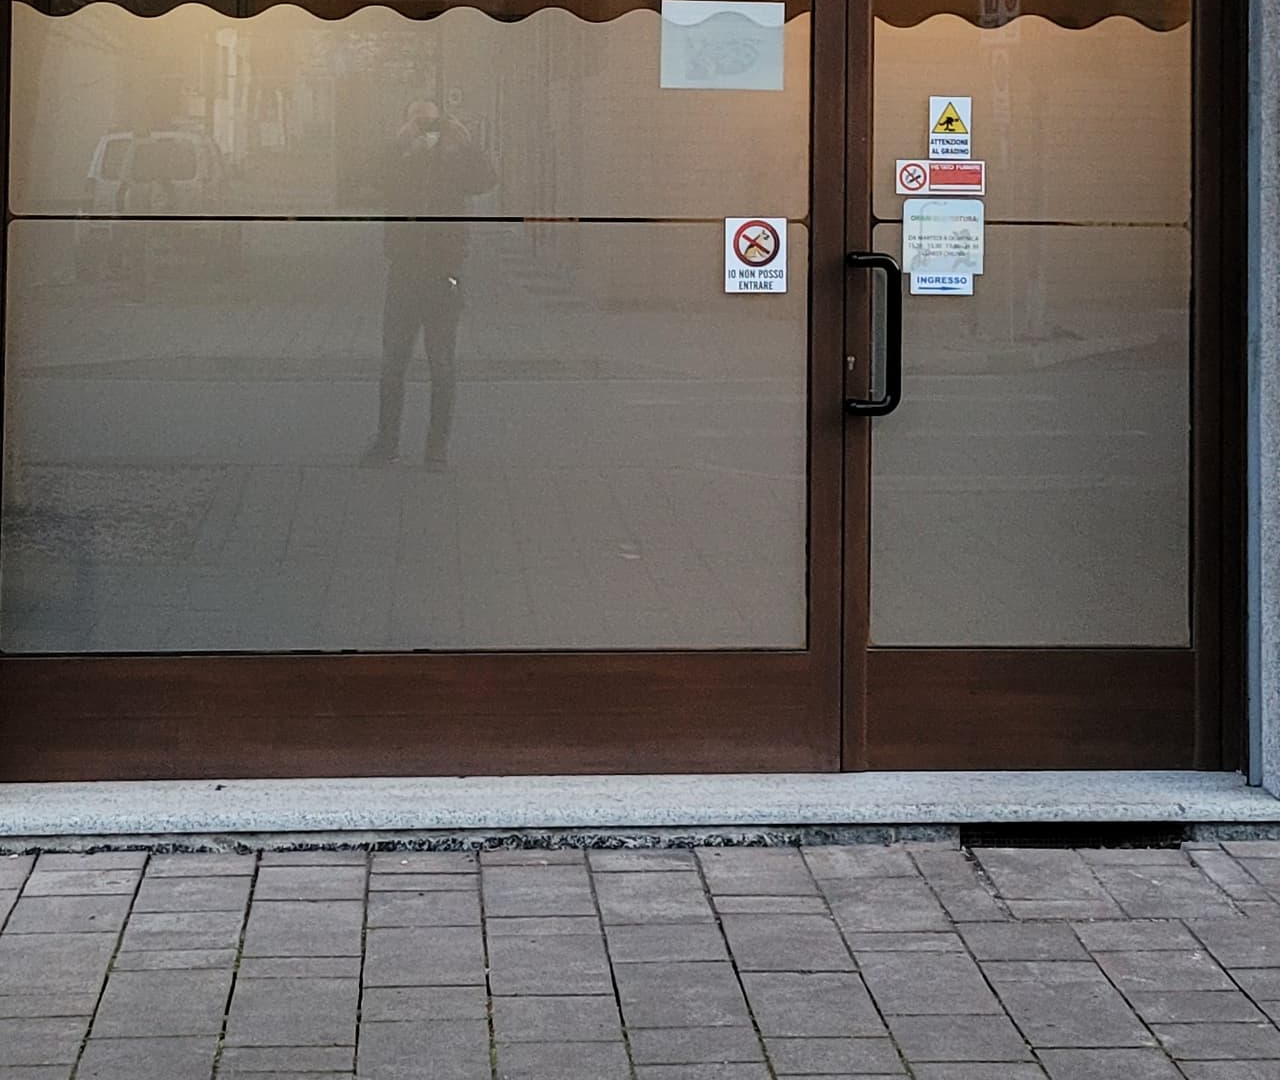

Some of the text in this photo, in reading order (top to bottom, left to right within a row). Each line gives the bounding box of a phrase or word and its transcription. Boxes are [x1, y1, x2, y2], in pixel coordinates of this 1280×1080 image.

[930, 138, 969, 146] ATTENZIONE
[728, 269, 784, 279] IO NON POSSO
[916, 276, 968, 284] INGRESSO
[738, 280, 774, 290] ENTRARE
